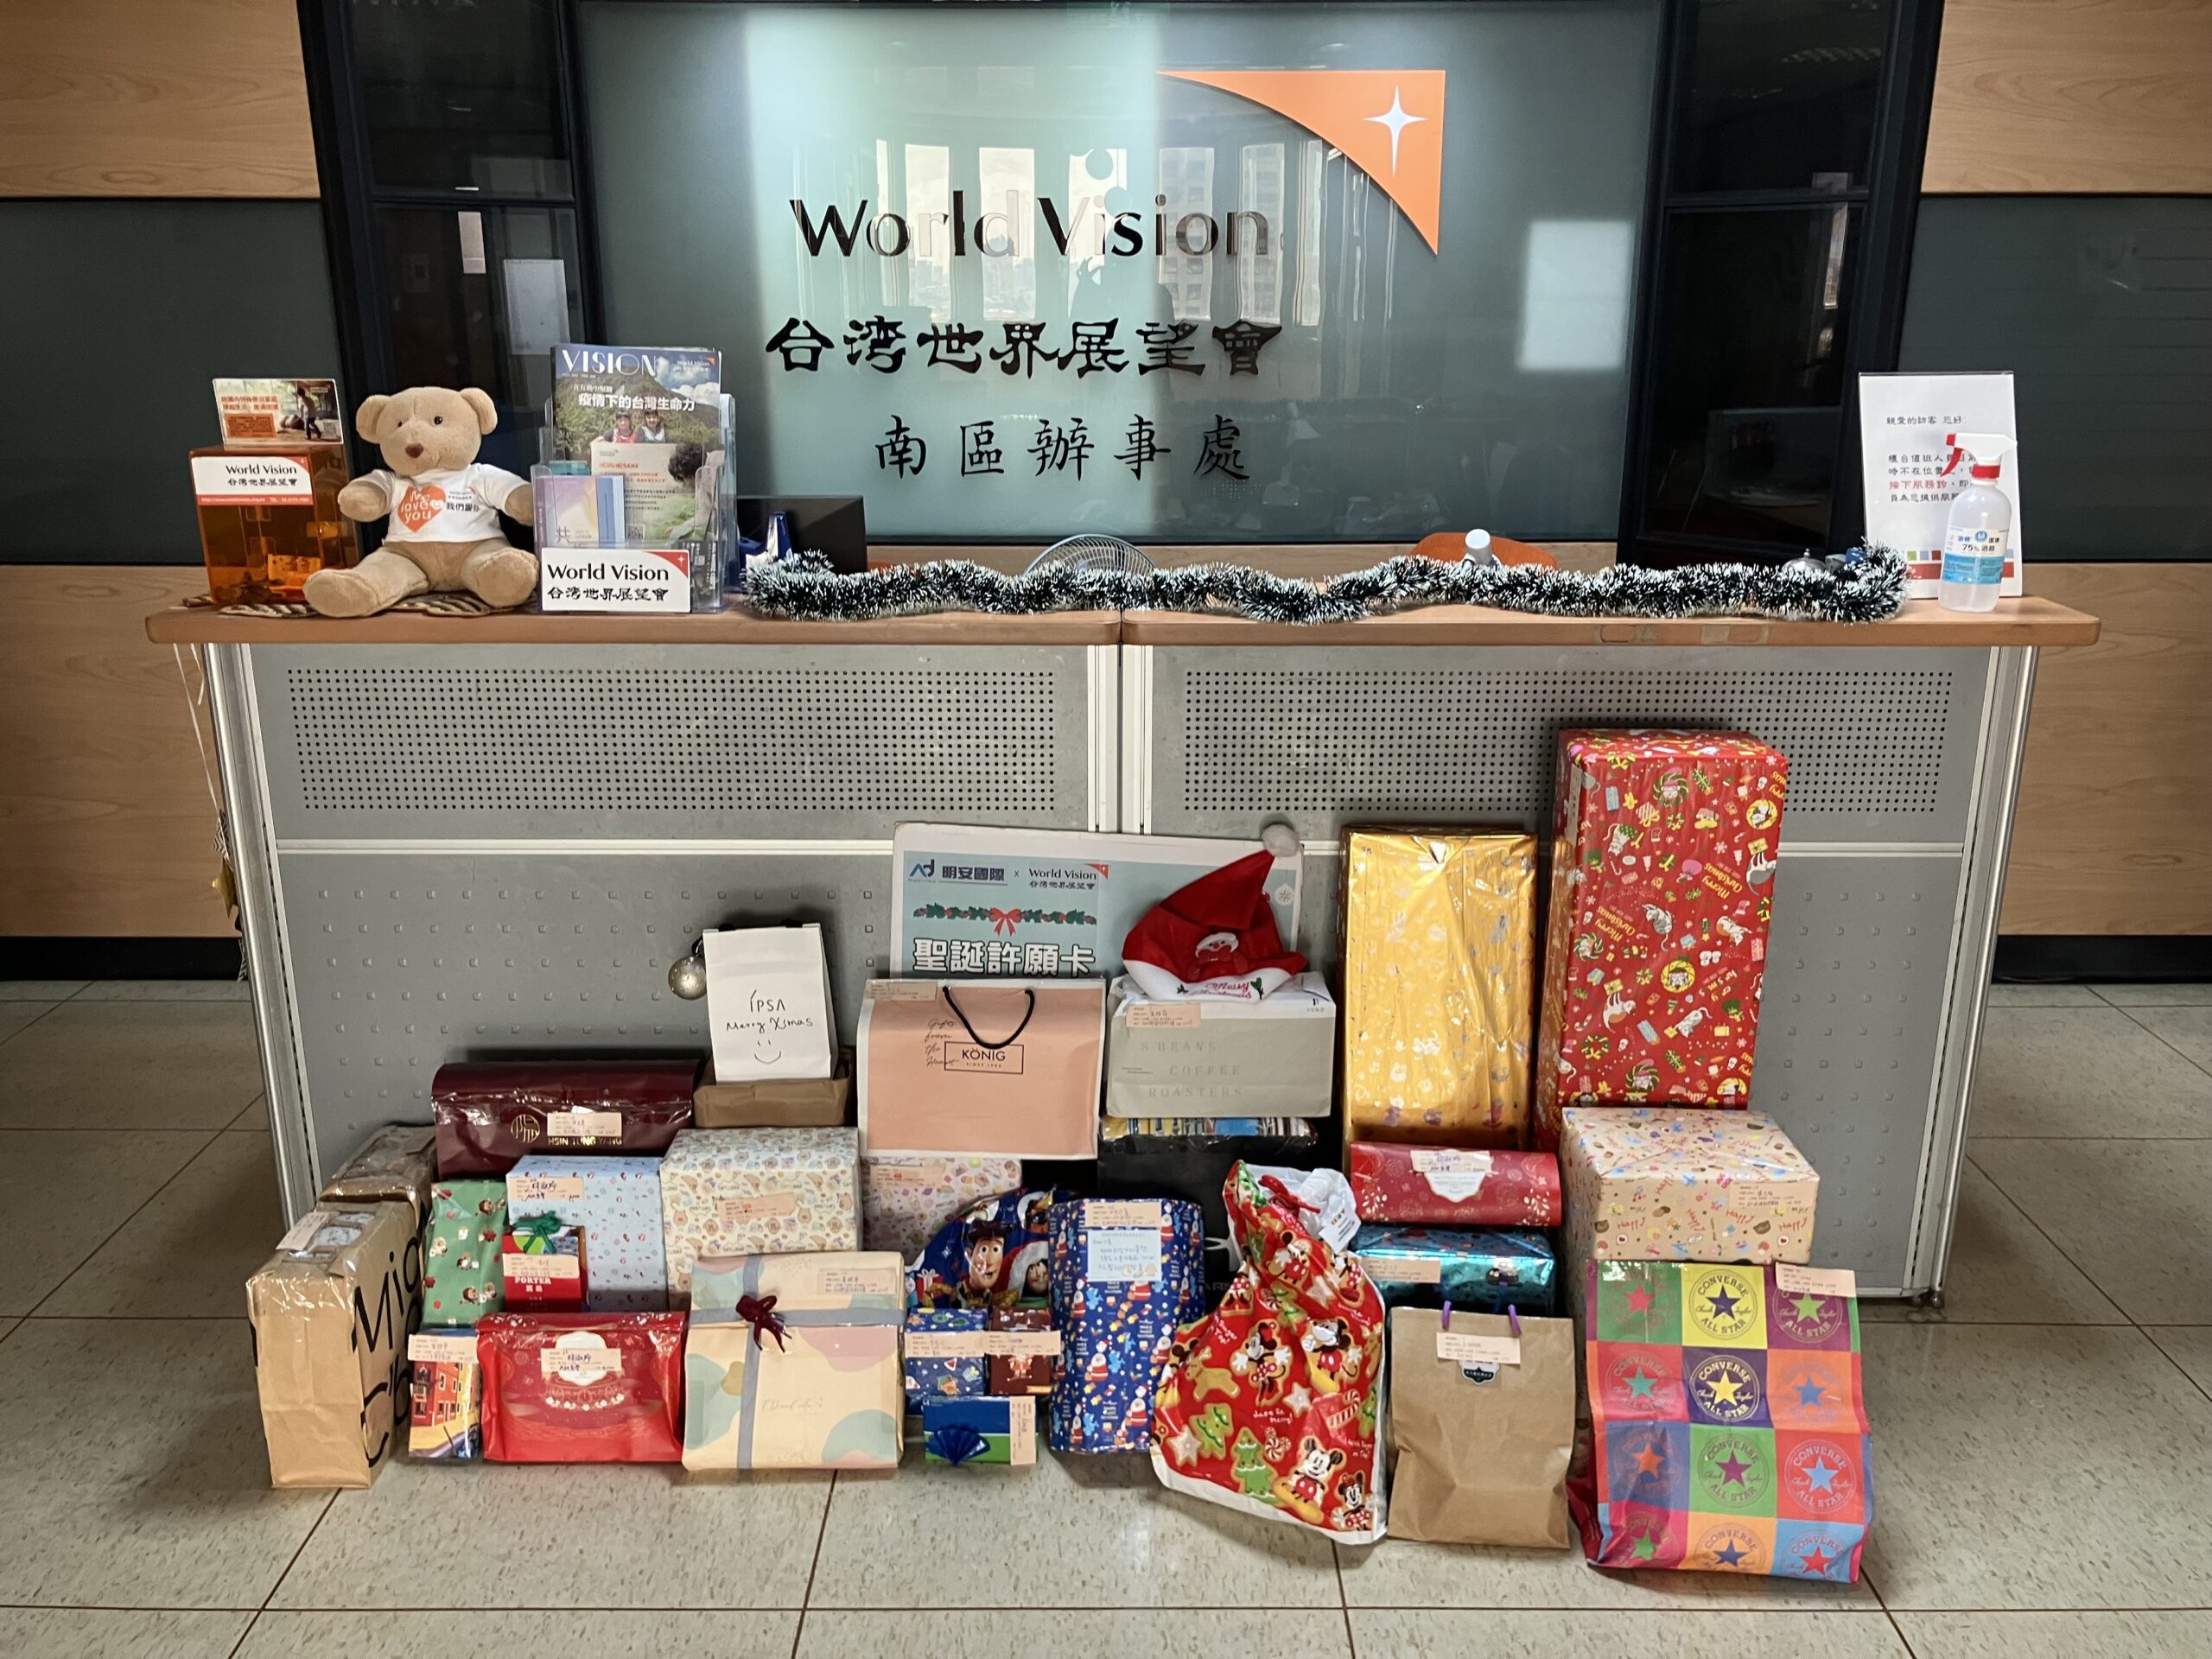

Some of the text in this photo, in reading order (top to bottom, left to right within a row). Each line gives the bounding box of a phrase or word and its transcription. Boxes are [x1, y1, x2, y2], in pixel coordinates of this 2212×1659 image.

[790, 190, 1269, 257] World Vision
[563, 349, 657, 377] VISION
[578, 393, 696, 411] 疫情下的台灣生命力
[875, 415, 1250, 481] 南區辦事處
[226, 464, 297, 474] World Vision
[401, 501, 429, 512] love
[404, 510, 432, 524] you
[547, 563, 670, 581] World Vision
[942, 866, 1005, 881] 明安國際
[1029, 868, 1062, 880] World
[1065, 869, 1097, 880] Vision
[913, 938, 1096, 978] 聖誕許願卡
[726, 1020, 766, 1034] Merry
[962, 1046, 1007, 1062] KÖNIG
[1169, 1065, 1243, 1077] COFFEE
[1148, 1086, 1243, 1099] ROASTERS
[548, 1136, 569, 1147] HSIN
[514, 1276, 552, 1286] PORTER
[1698, 1274, 1749, 1297] CONVERSE
[1701, 1317, 1746, 1334] ALL STAR
[1785, 1320, 1831, 1337] ALL STAR
[1699, 1361, 1751, 1383] CONVERSE
[1704, 1402, 1750, 1418] ALL STAR
[1706, 1439, 1760, 1464] CONVERSE
[1793, 1446, 1847, 1470] CONVERSE
[1711, 1484, 1758, 1502] ALL STAR
[1797, 1489, 1844, 1508] ALL STAR
[1704, 1529, 1758, 1551] CONVERSE
